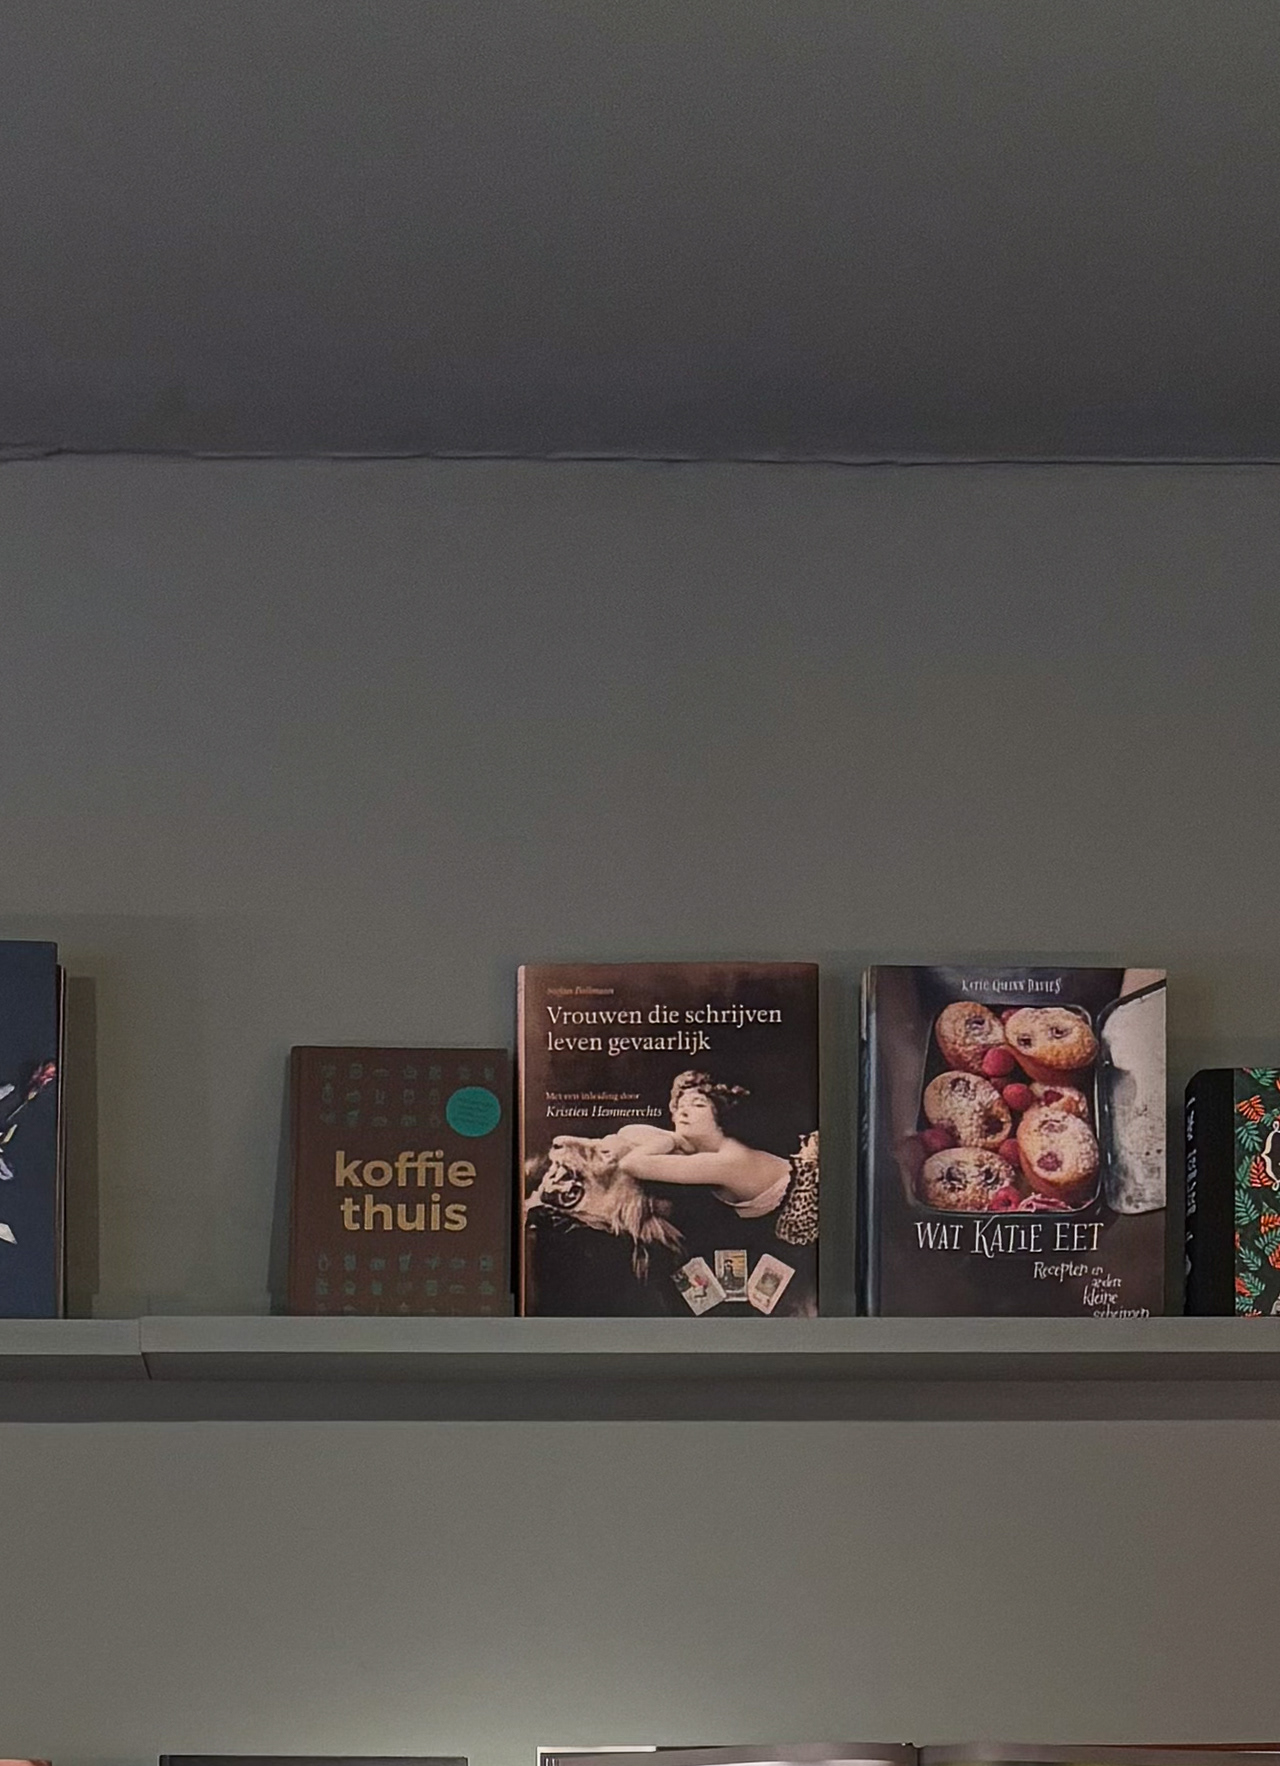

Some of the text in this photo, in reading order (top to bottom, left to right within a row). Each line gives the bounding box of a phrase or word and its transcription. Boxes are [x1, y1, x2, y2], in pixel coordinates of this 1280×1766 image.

[547, 1004, 782, 1029] Vrouwen die schrijven
[547, 1030, 711, 1056] leven gevaarlijk
[546, 1105, 662, 1118] Kristien Hemmerechts
[334, 1149, 477, 1188] koffie
[341, 1194, 468, 1231] thuis
[914, 1221, 964, 1250] WAT
[1052, 1222, 1104, 1251] EET
[1033, 1261, 1088, 1283] Recepten
[1082, 1285, 1119, 1306] kleine
